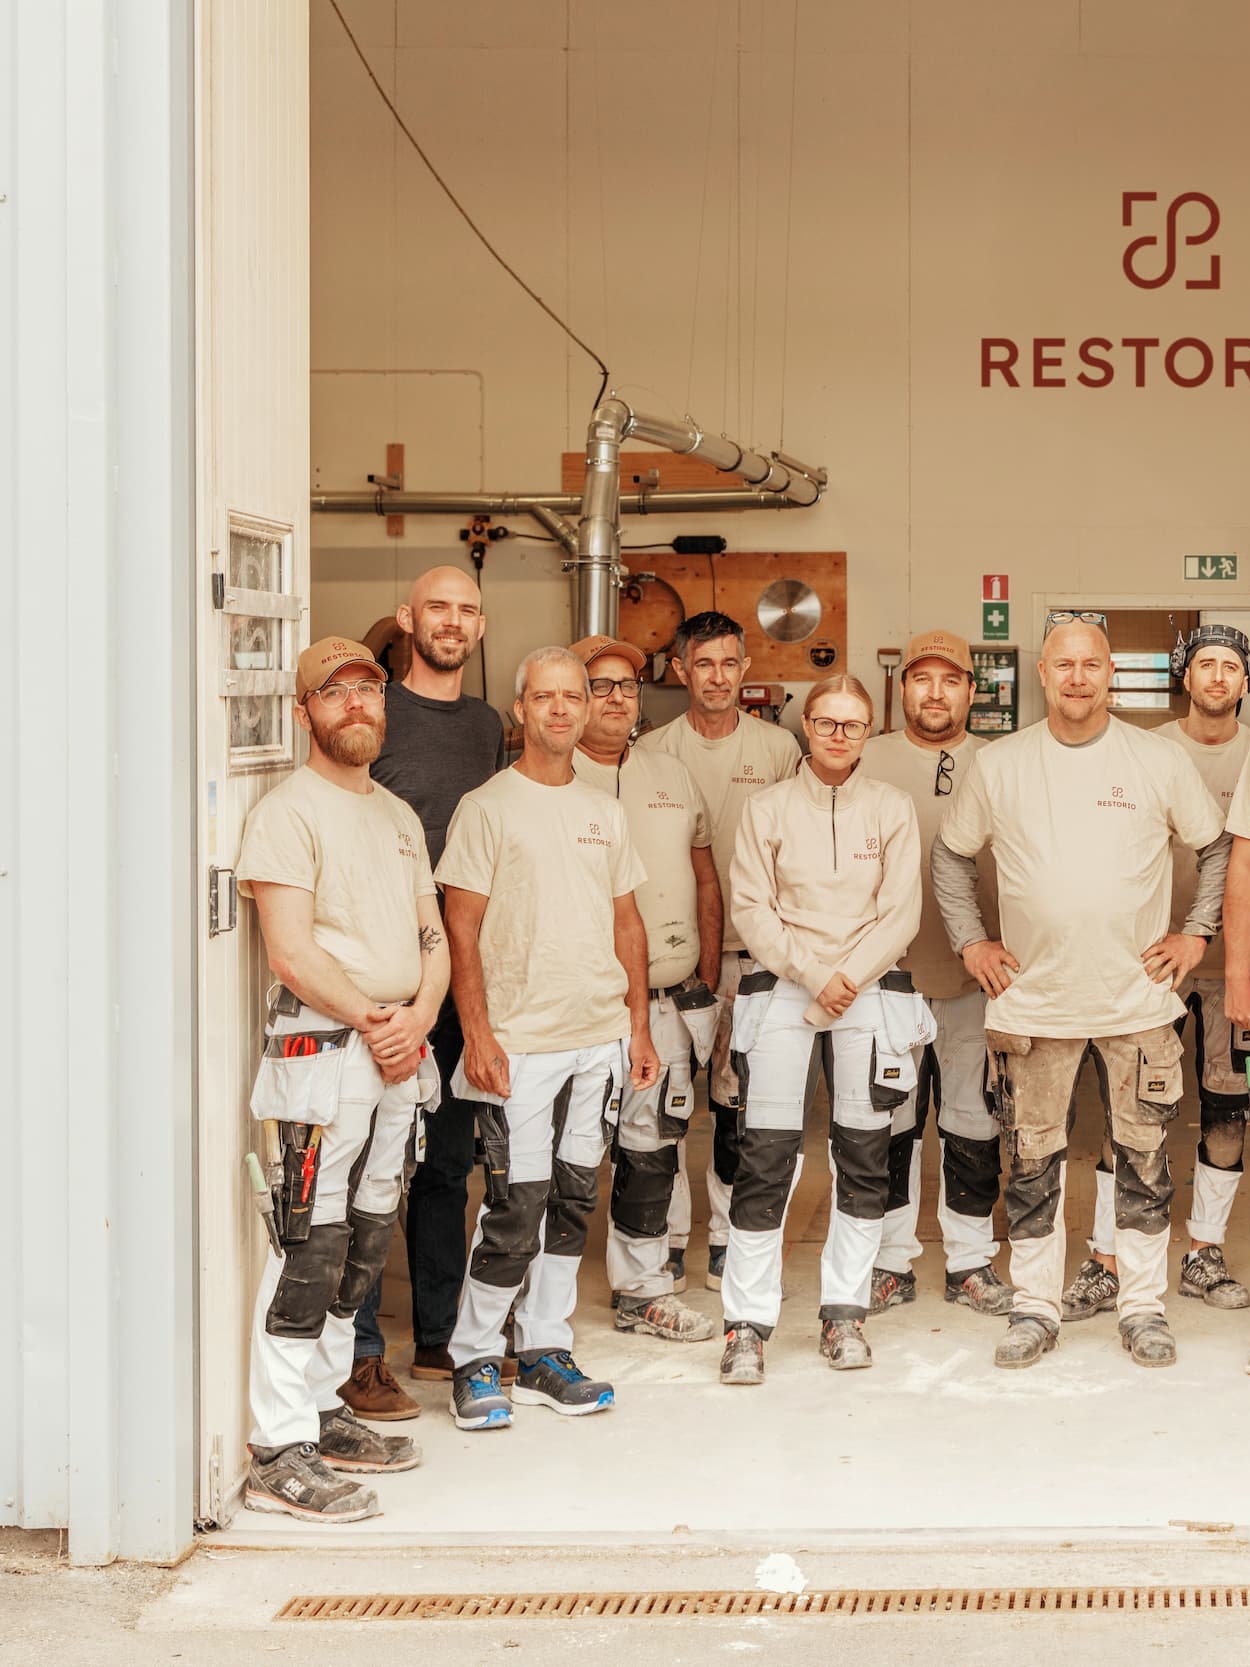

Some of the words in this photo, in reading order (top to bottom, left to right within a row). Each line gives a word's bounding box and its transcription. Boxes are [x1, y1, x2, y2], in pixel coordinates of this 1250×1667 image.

[732, 777, 766, 785] RESTORIO
[648, 801, 685, 810] RESTORIO
[1097, 799, 1137, 811] RESTORIO
